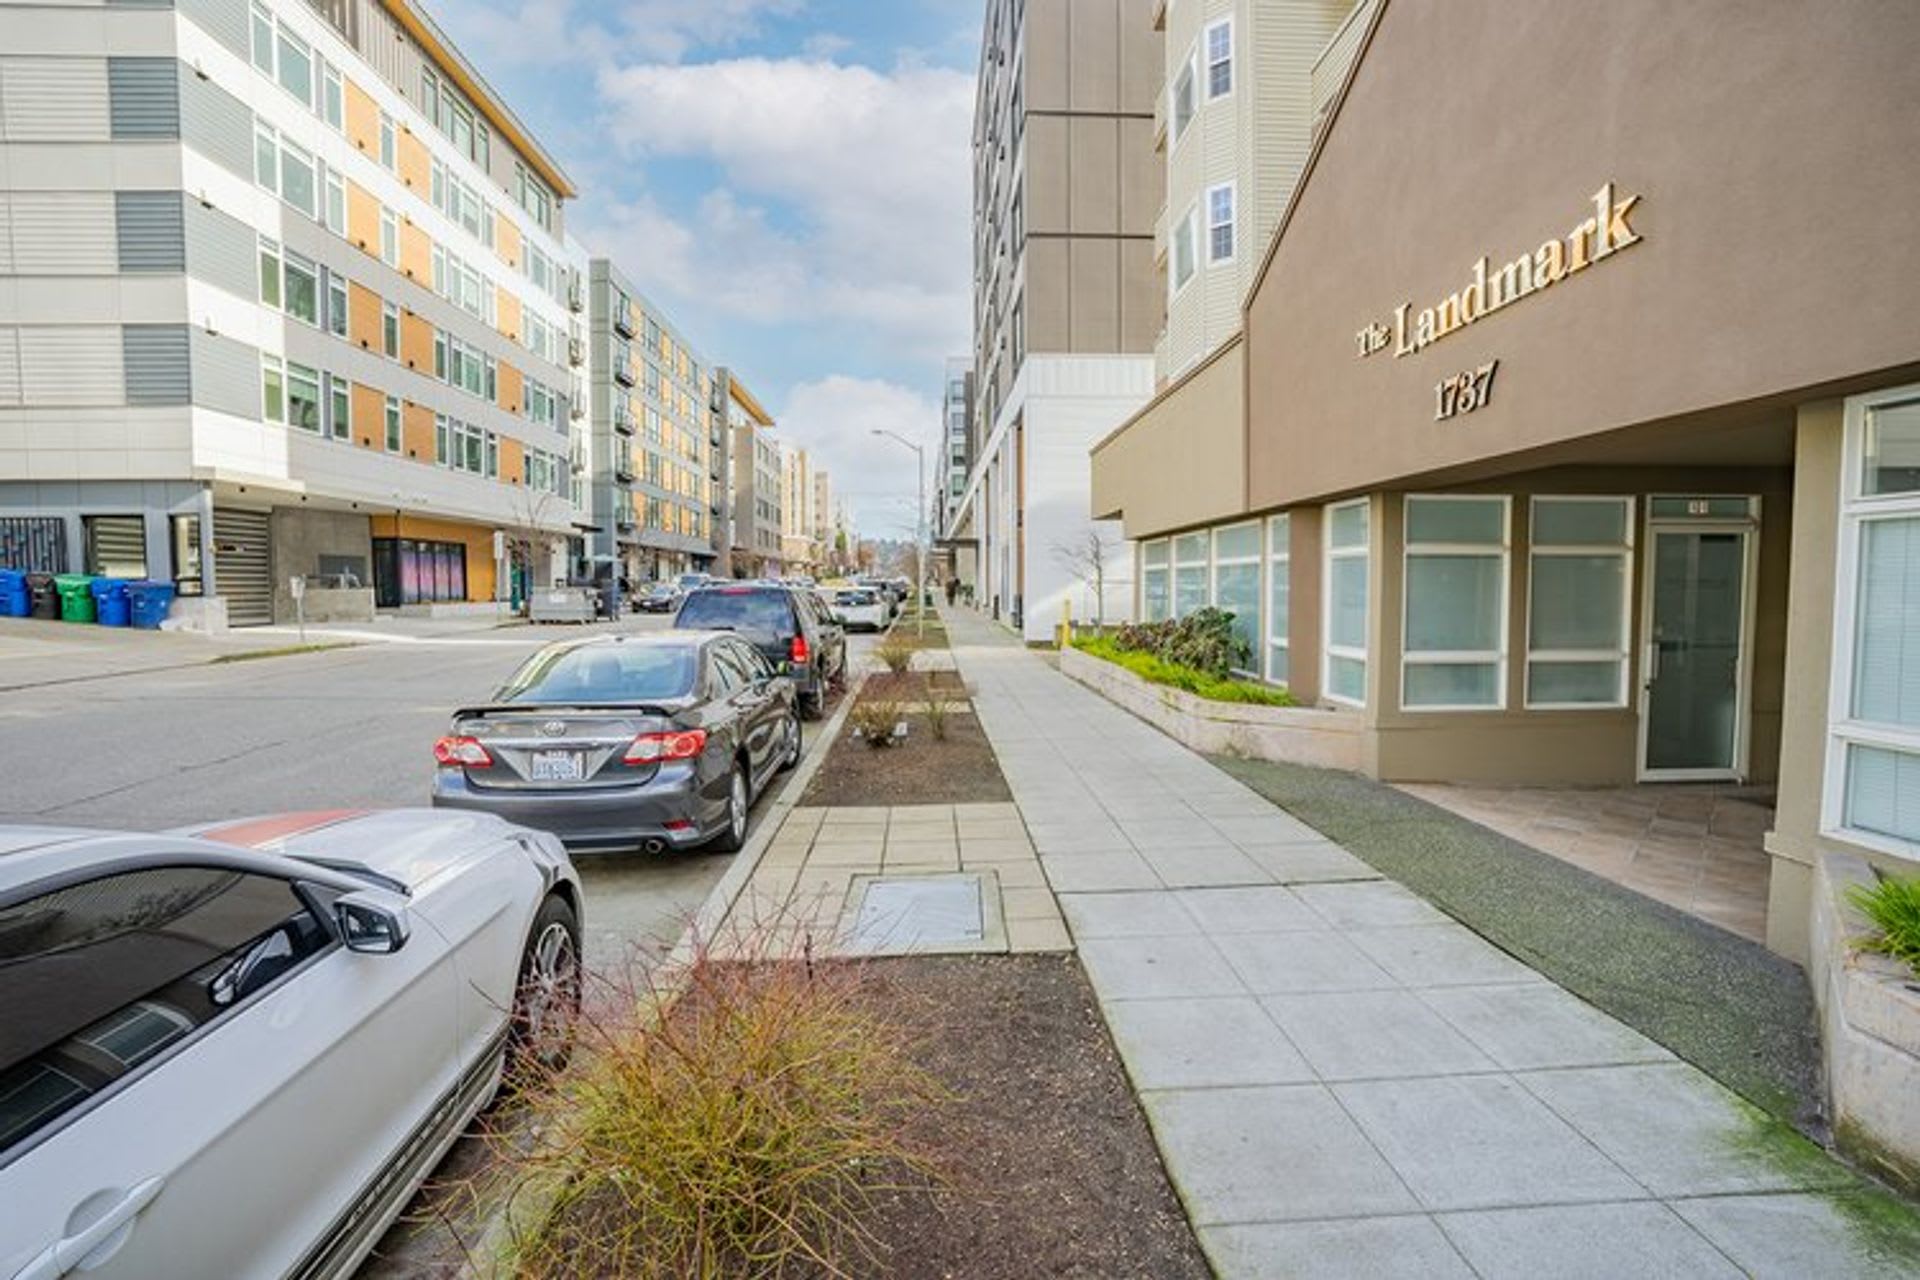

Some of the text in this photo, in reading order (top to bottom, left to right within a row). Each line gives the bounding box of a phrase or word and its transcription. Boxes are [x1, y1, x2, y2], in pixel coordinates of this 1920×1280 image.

[1355, 181, 1643, 358] The Landmark
[1433, 358, 1499, 421] 1737
